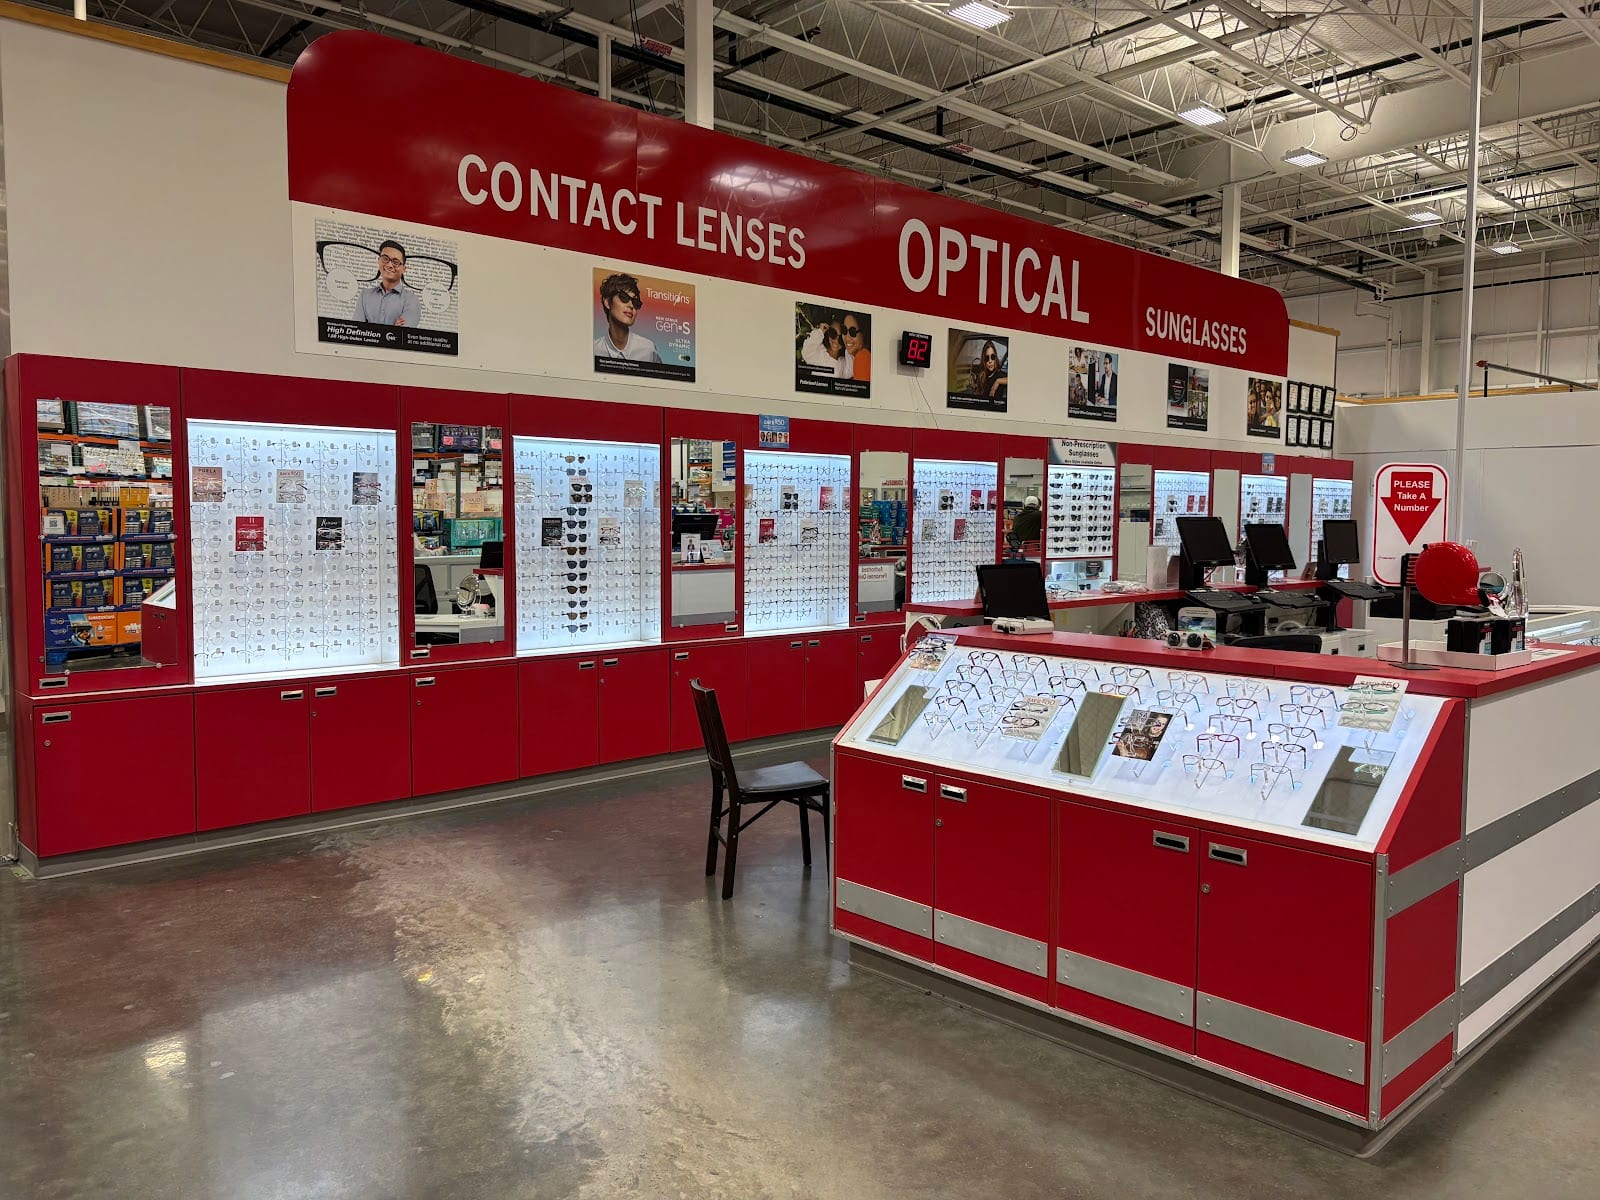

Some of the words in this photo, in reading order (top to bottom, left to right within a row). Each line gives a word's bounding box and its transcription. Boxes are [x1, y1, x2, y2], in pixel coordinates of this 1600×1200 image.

[457, 154, 662, 239] CONTACT
[676, 202, 806, 269] LENSES
[898, 218, 1090, 324] OPTICAL
[646, 287, 690, 306] Transitions
[326, 326, 345, 336] High
[346, 328, 381, 338] Definition
[1145, 306, 1247, 355] SUNGLASSES
[908, 339, 928, 360] 82
[1061, 440, 1106, 450] Non-Prescription
[1069, 449, 1099, 458] Sunglasses
[1394, 480, 1430, 488] PLEASE
[1394, 504, 1429, 512] Number
